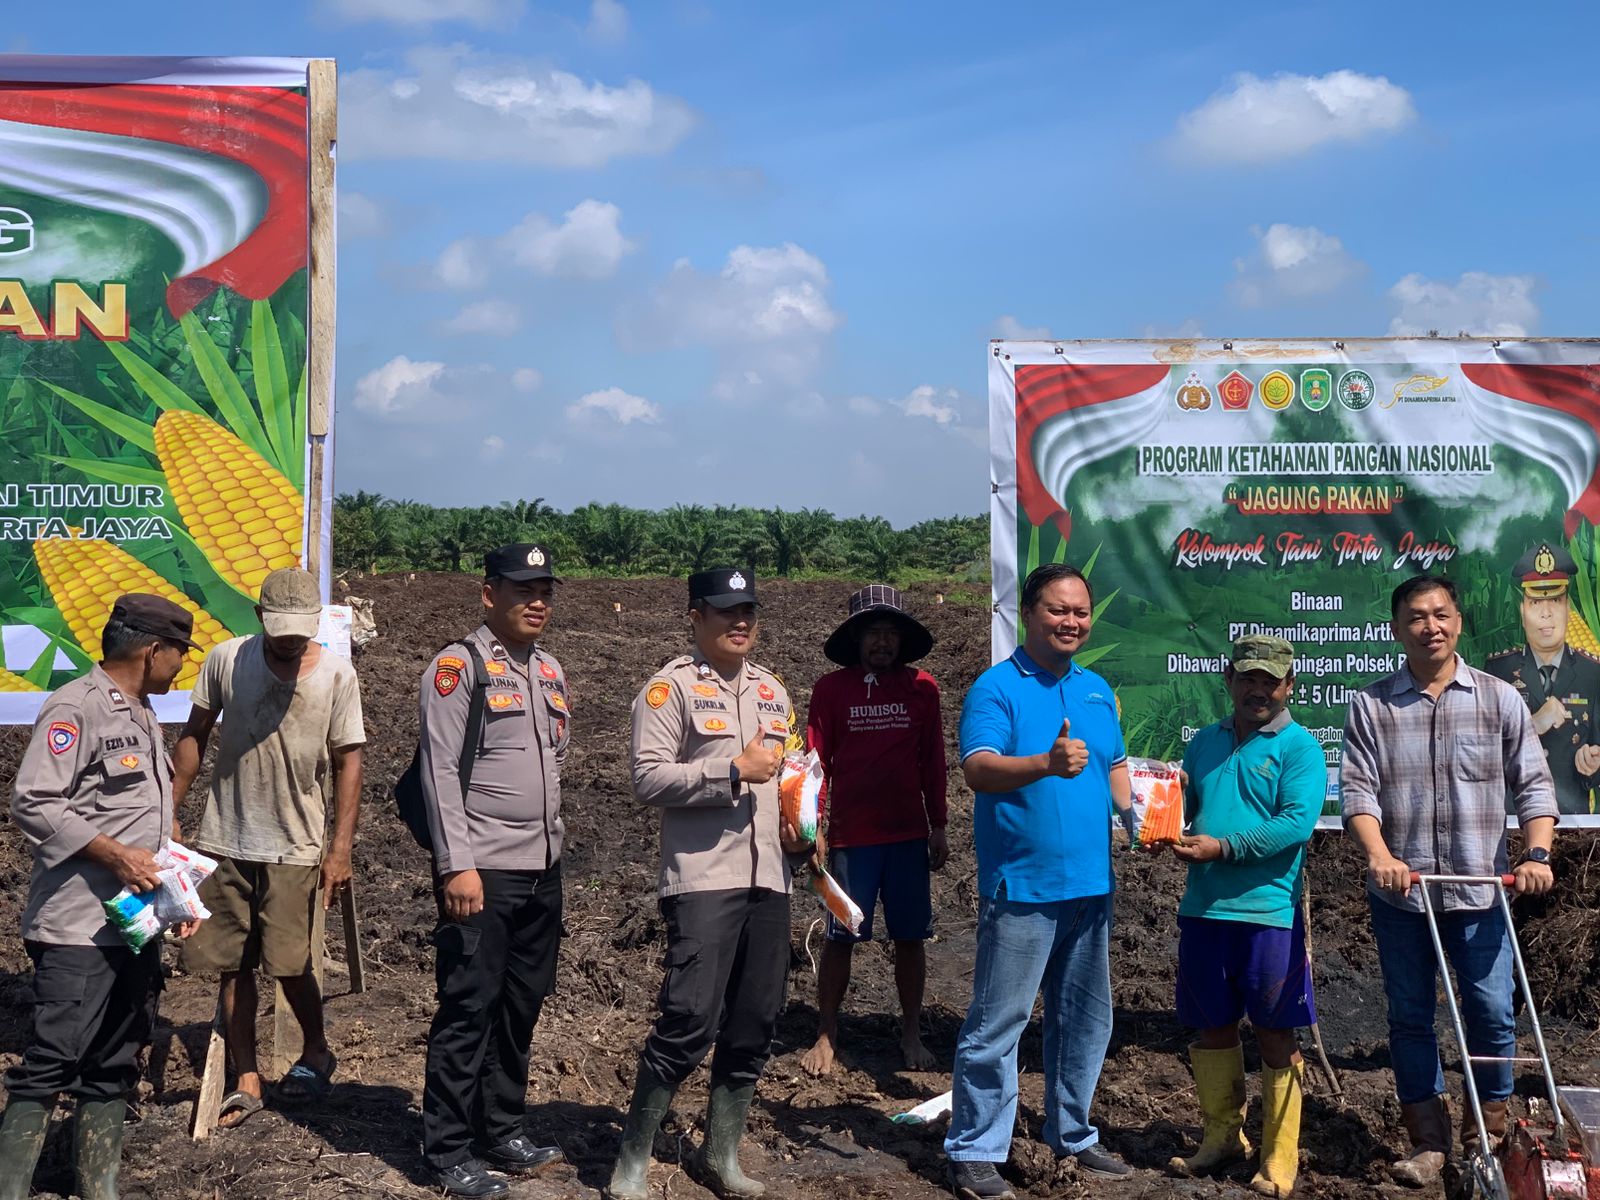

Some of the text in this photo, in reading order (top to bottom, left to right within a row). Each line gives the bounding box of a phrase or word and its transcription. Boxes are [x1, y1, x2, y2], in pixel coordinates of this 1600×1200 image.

[0, 281, 127, 337] AN
[1142, 444, 1492, 473] PROGRAM KETAHANAN PANGAN NASIONAL
[26, 484, 165, 508] TIMUR
[1243, 485, 1320, 511] JAGUNG
[1327, 485, 1389, 511] PAKAN
[0, 516, 173, 541] RTA JAYA
[1176, 529, 1456, 570] Kelompok Tani Tirta Jaya
[1291, 591, 1343, 611] Binaan
[1229, 622, 1395, 646] PT Dinamikaprima Arth
[1167, 653, 1230, 673] Dibawah
[1292, 653, 1342, 677] pingan
[1346, 653, 1394, 673] Polsek
[491, 677, 520, 690] UNAN
[757, 702, 785, 714] POLRI
[1312, 685, 1322, 704] 5
[1325, 684, 1357, 708] (Lim
[849, 703, 908, 718] HUMISOL
